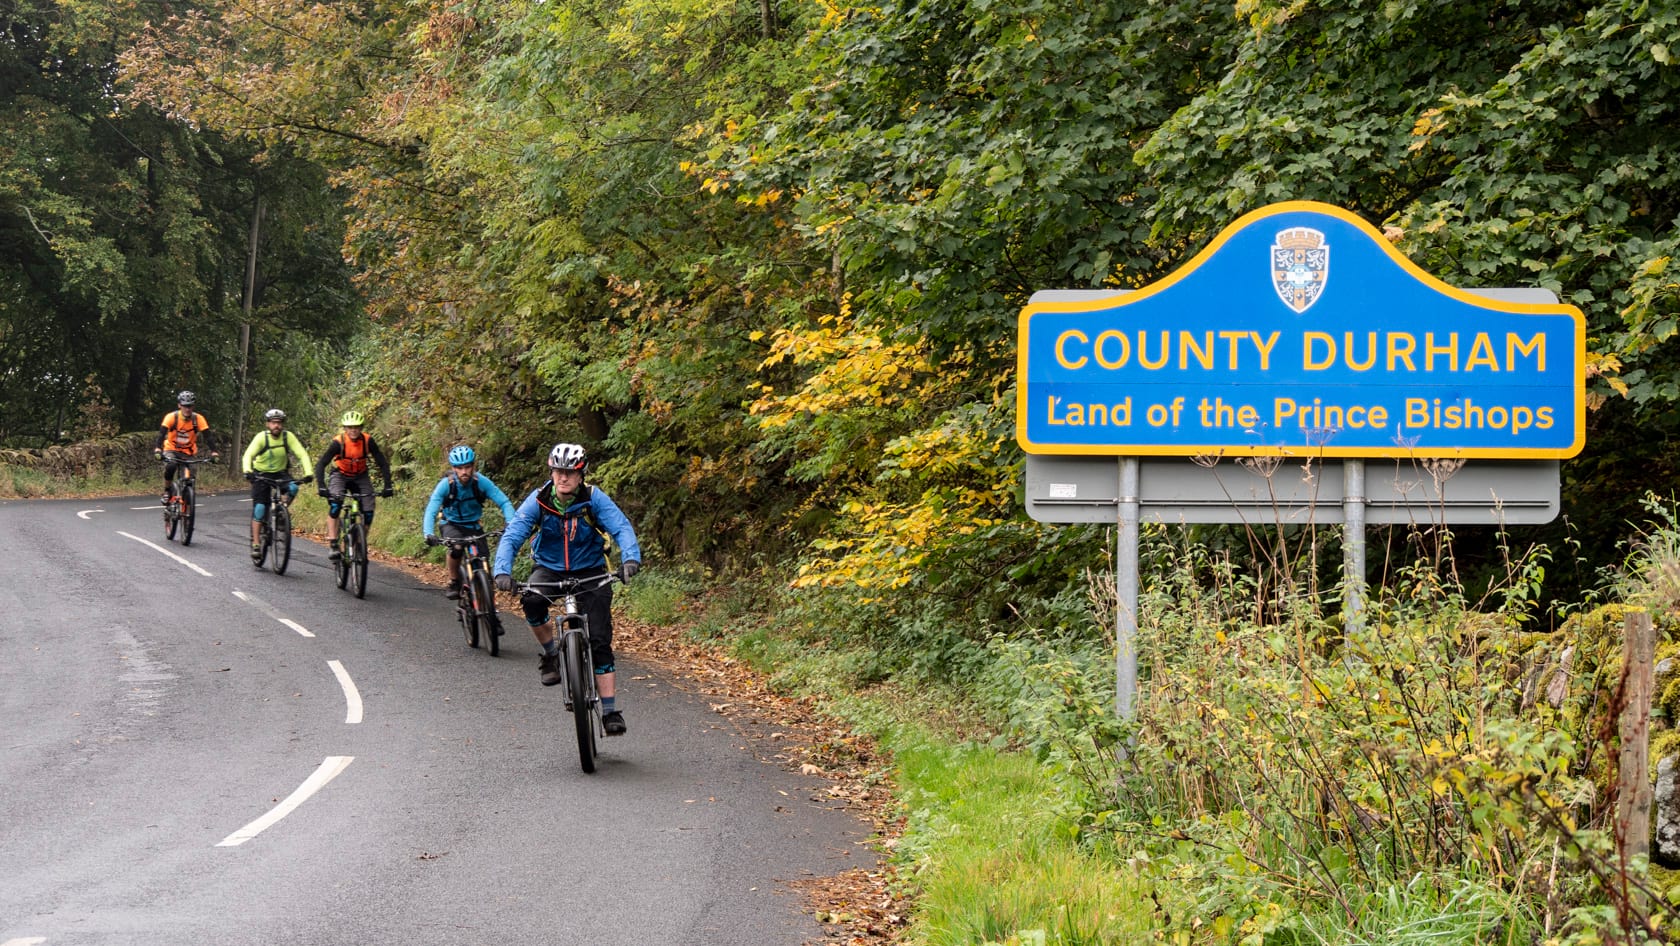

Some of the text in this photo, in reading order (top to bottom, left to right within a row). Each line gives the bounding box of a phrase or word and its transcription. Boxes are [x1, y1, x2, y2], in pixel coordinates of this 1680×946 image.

[1055, 330, 1546, 371] COUNTY DURHAM
[1048, 396, 1554, 434] Land of the Prince Bishops
